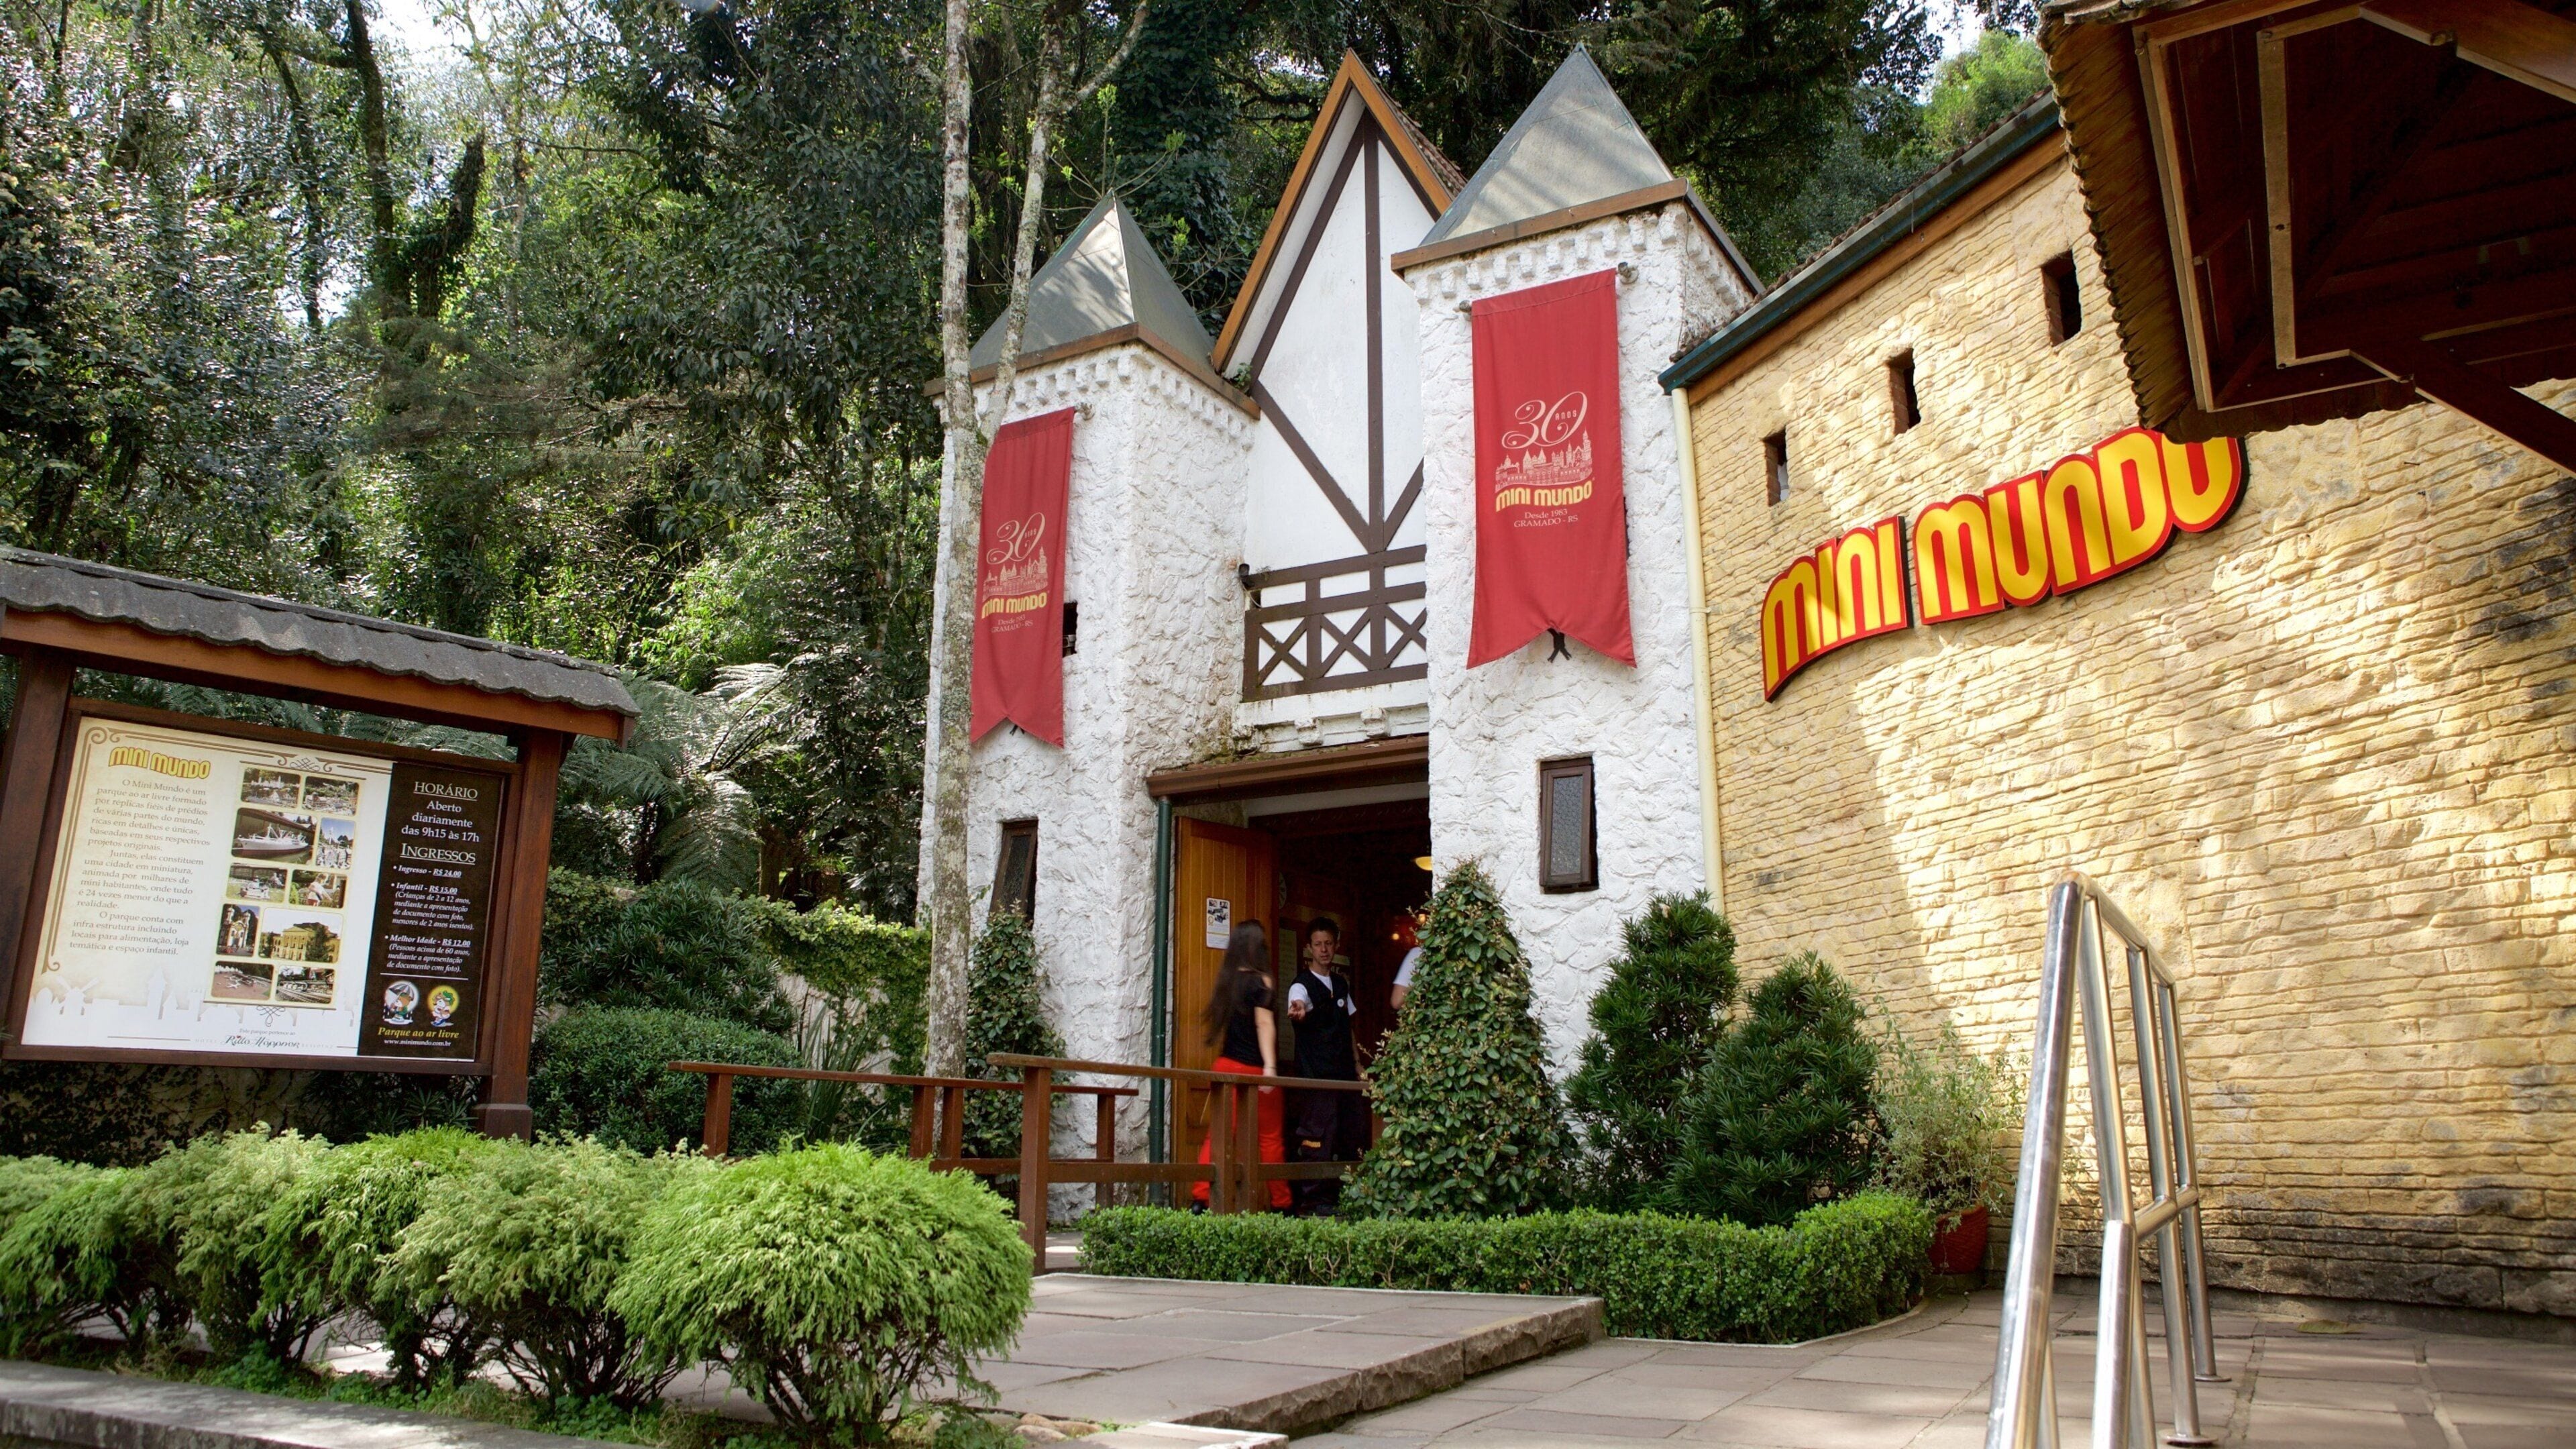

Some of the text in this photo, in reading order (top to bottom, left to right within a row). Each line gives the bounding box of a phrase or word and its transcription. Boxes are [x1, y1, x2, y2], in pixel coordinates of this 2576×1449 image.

[1501, 391, 1587, 449] 30
[1555, 410, 1576, 420] ANOS
[1496, 480, 1592, 512] MINI MUNDO
[1550, 509, 1567, 517] 1983
[1514, 518, 1560, 527] GRAMADO
[987, 513, 1045, 565] 30
[1762, 427, 2243, 701] MINI MUNDO
[982, 592, 1047, 619] MINI MUNDO
[991, 623, 1021, 633] GRAMADO
[108, 747, 211, 779] MINI MUNDO
[132, 781, 152, 789] Mini
[154, 783, 184, 793] Mundo
[414, 782, 478, 799] HORÁRIO
[97, 787, 127, 797] parque
[152, 793, 170, 801] livre
[172, 794, 207, 806] formado
[112, 798, 144, 808] réplicas
[166, 803, 175, 812] de
[178, 804, 208, 816] prédios
[427, 800, 462, 812] Aberto
[107, 807, 131, 817] várias
[134, 811, 159, 820] partes
[161, 812, 172, 821] do
[412, 812, 473, 828] diariamente
[92, 817, 111, 825] ricas
[129, 820, 163, 830] detalhes
[90, 827, 127, 837] baseadas
[165, 835, 211, 846] respectivos
[401, 825, 480, 842] das 9h15 às 17h
[88, 838, 122, 847] projetos
[110, 850, 204, 865] Juntas, elas constituem
[400, 843, 476, 863] INGRESSOS
[106, 859, 134, 869] cidade
[398, 865, 427, 874] Ingresso
[82, 869, 119, 877] animada
[142, 873, 176, 883] milhares
[150, 885, 171, 893] onde
[174, 886, 193, 894] tudo
[396, 882, 423, 891] Infantil
[124, 894, 151, 902] menor
[153, 894, 164, 902] do
[395, 892, 425, 900] (Crianças
[394, 900, 423, 908] mediante
[429, 904, 468, 912] apresentação
[109, 913, 140, 922] parque
[142, 915, 164, 923] conta
[402, 909, 436, 918] documento
[96, 922, 135, 931] estrutura
[138, 924, 177, 934] incluindo
[72, 930, 96, 938] locais
[98, 933, 117, 941] para
[174, 938, 189, 947] loja
[390, 934, 416, 943] Melhor
[70, 941, 106, 951] temática
[115, 945, 144, 954] espaço
[389, 943, 415, 952] (Pessoas
[396, 961, 430, 970] documento
[423, 956, 462, 964] apresentação
[378, 1026, 411, 1038] Parque
[438, 1030, 460, 1038] livre
